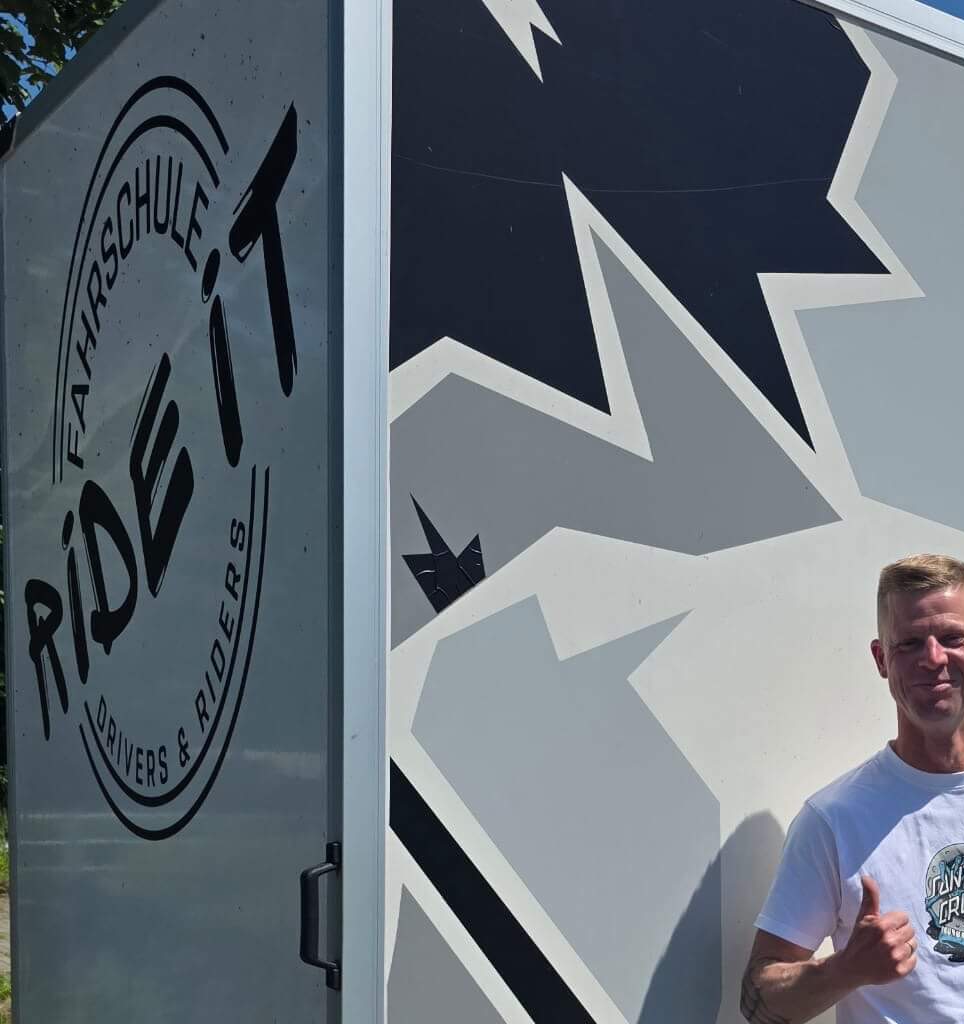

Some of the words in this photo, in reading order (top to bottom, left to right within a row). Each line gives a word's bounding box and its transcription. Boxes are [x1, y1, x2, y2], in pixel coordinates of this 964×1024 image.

[67, 156, 209, 469] FAHRSCHULE
[96, 695, 169, 787] DRIVERS
[178, 727, 191, 767] &
[194, 517, 246, 731] RIDERS
